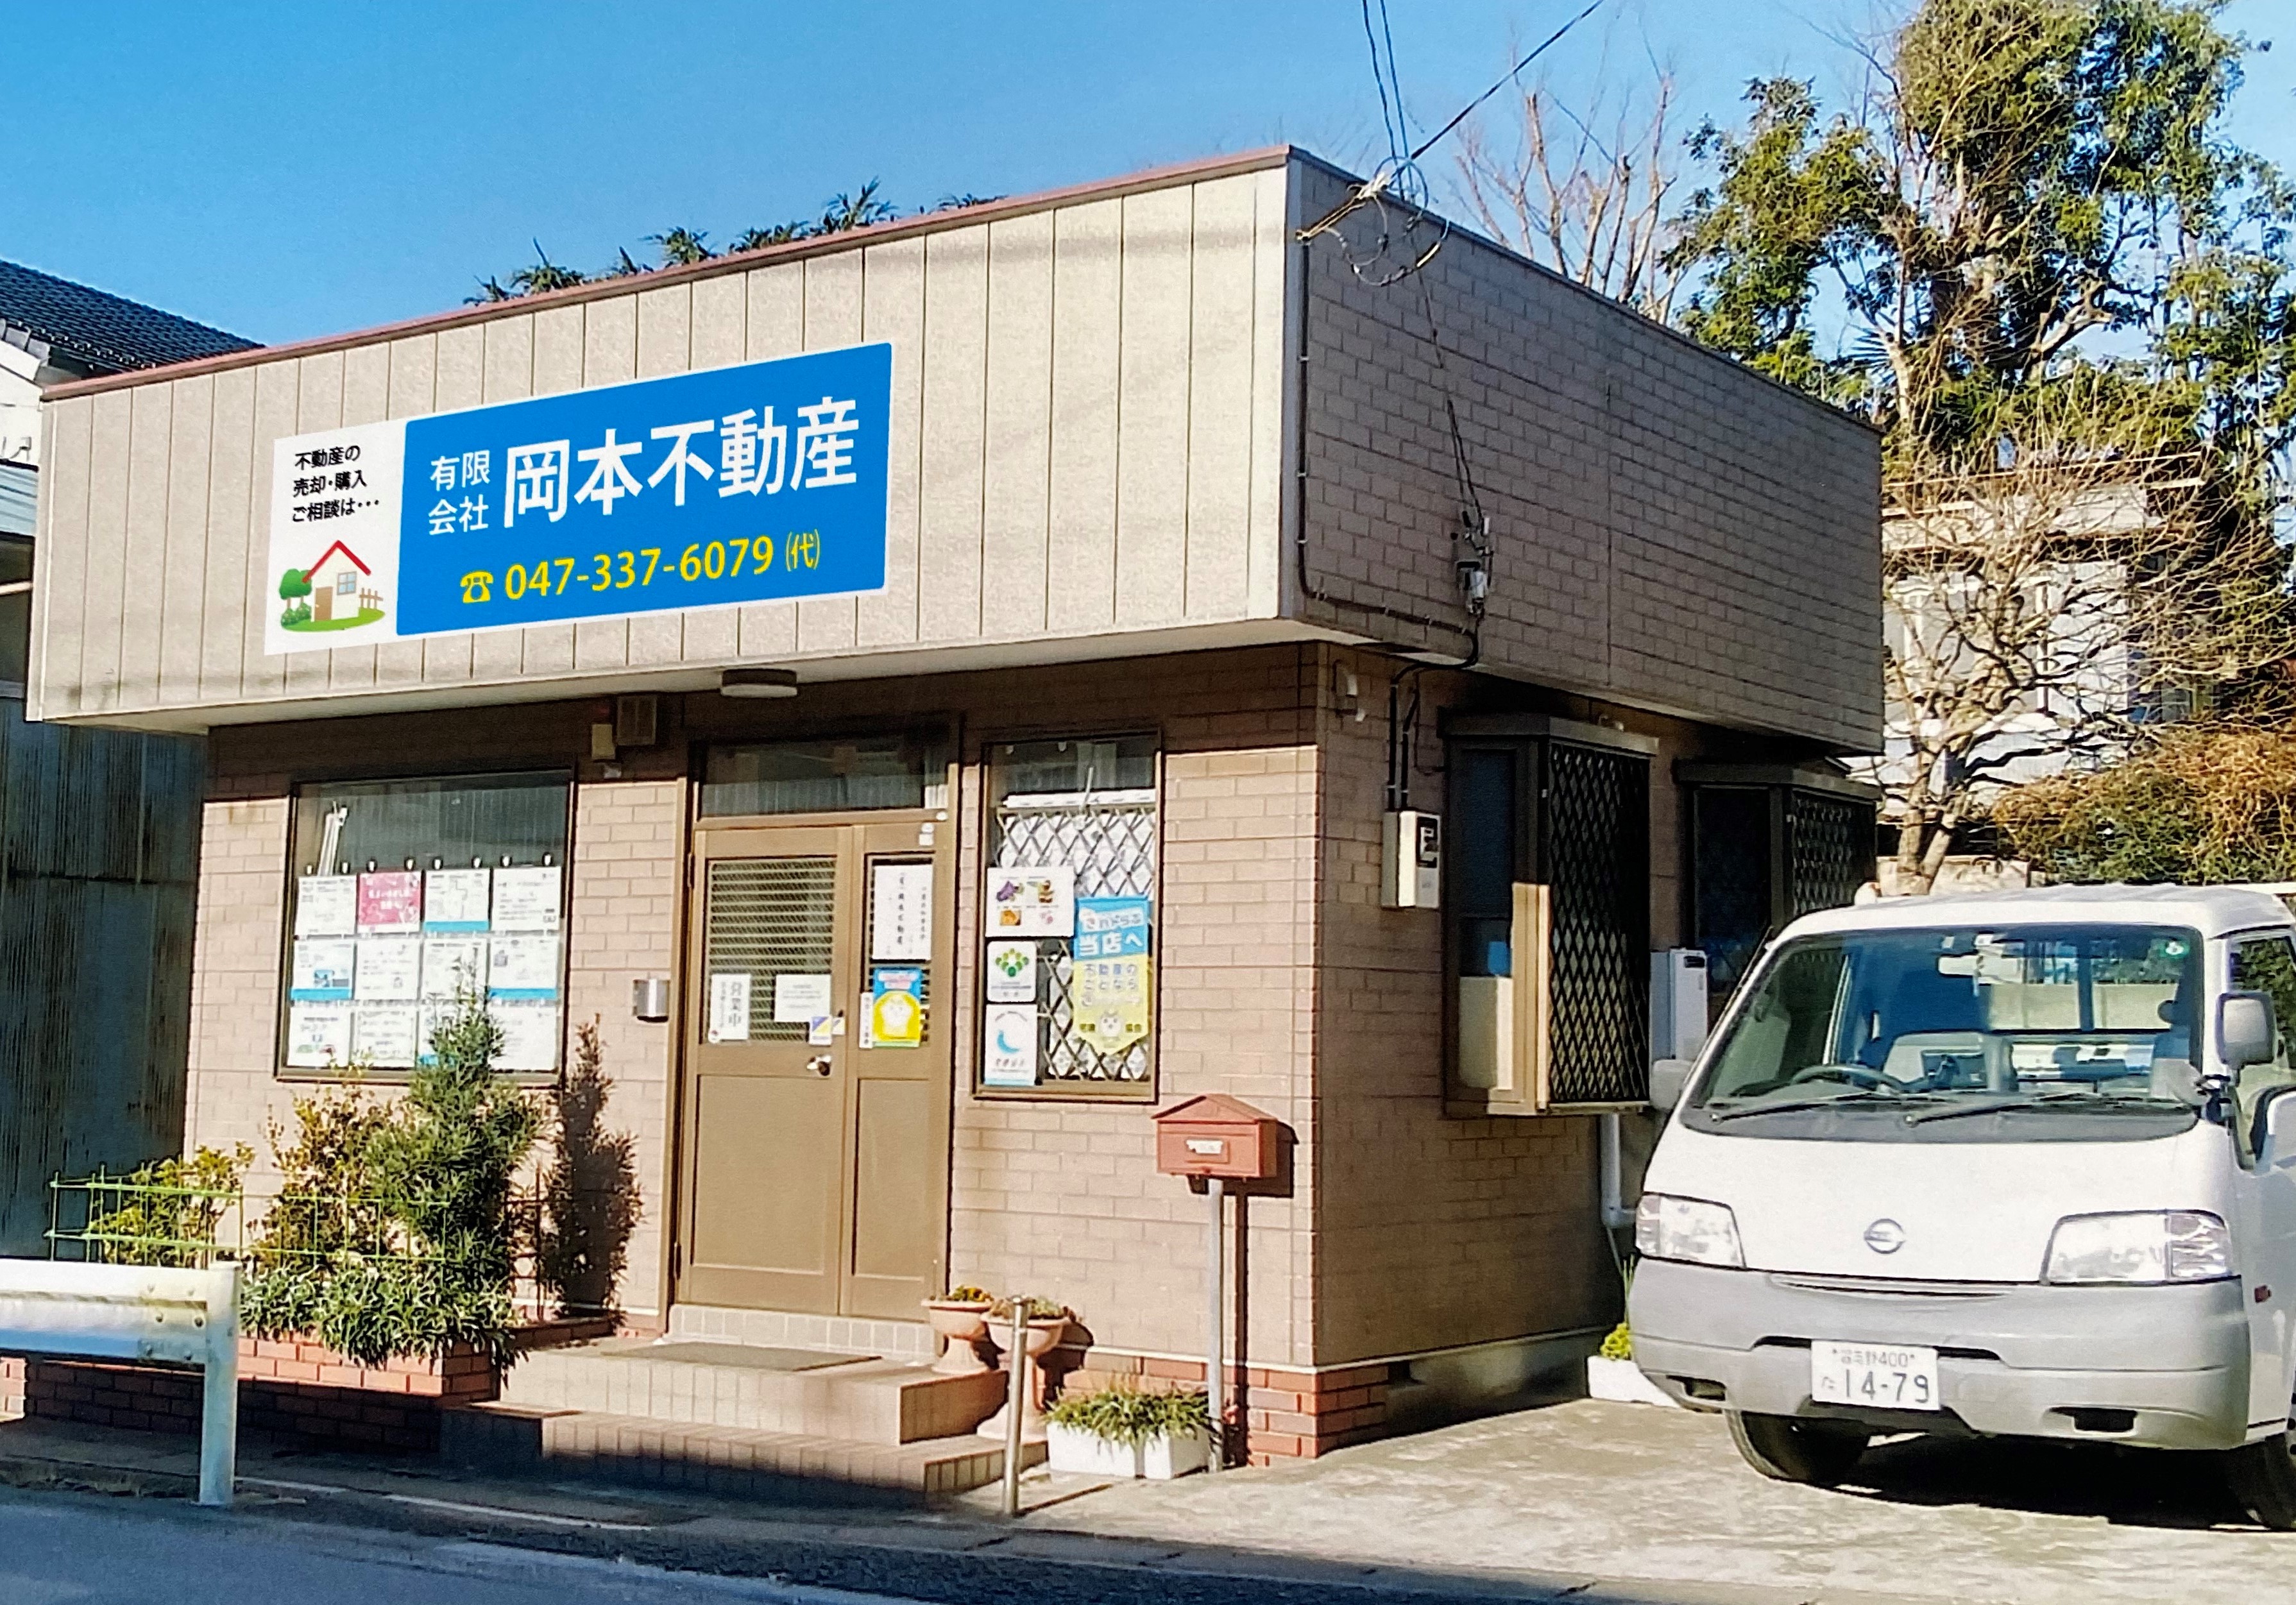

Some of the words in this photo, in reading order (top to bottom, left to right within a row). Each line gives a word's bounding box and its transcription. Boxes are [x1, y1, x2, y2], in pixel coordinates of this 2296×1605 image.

[294, 445, 361, 470] 不動産の
[430, 449, 490, 491] 有限
[504, 396, 858, 527] 岡本不動産
[429, 495, 489, 535] 会社
[504, 535, 774, 600] 047-337-6079
[1845, 1369, 1930, 1404] 14-79
